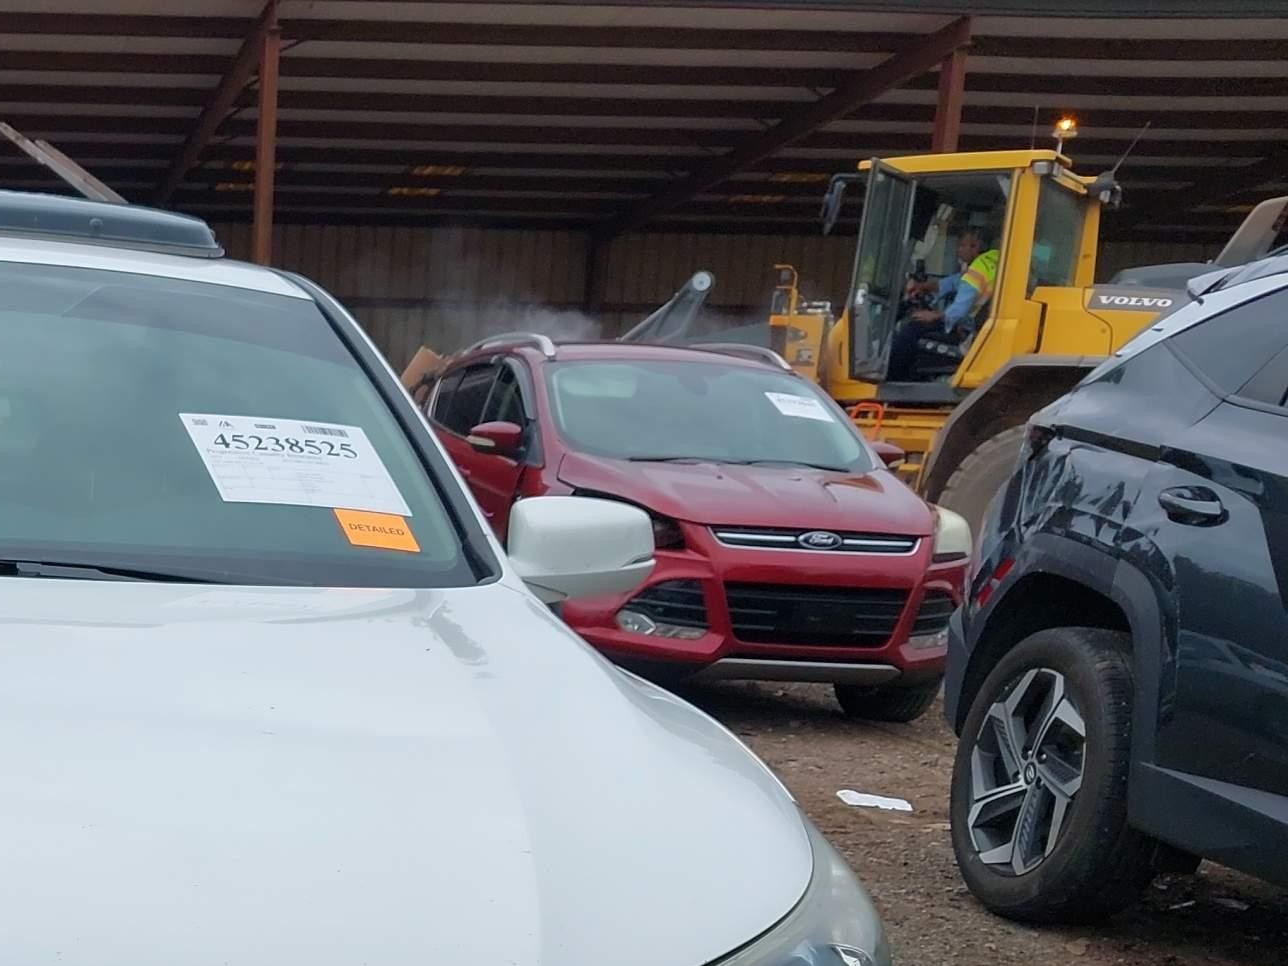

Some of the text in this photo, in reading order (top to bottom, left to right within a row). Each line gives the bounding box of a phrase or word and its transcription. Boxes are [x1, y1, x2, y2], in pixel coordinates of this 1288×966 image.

[1098, 295, 1173, 308] VOLVO
[214, 433, 358, 459] 45238525
[348, 522, 406, 537] DETAILED
